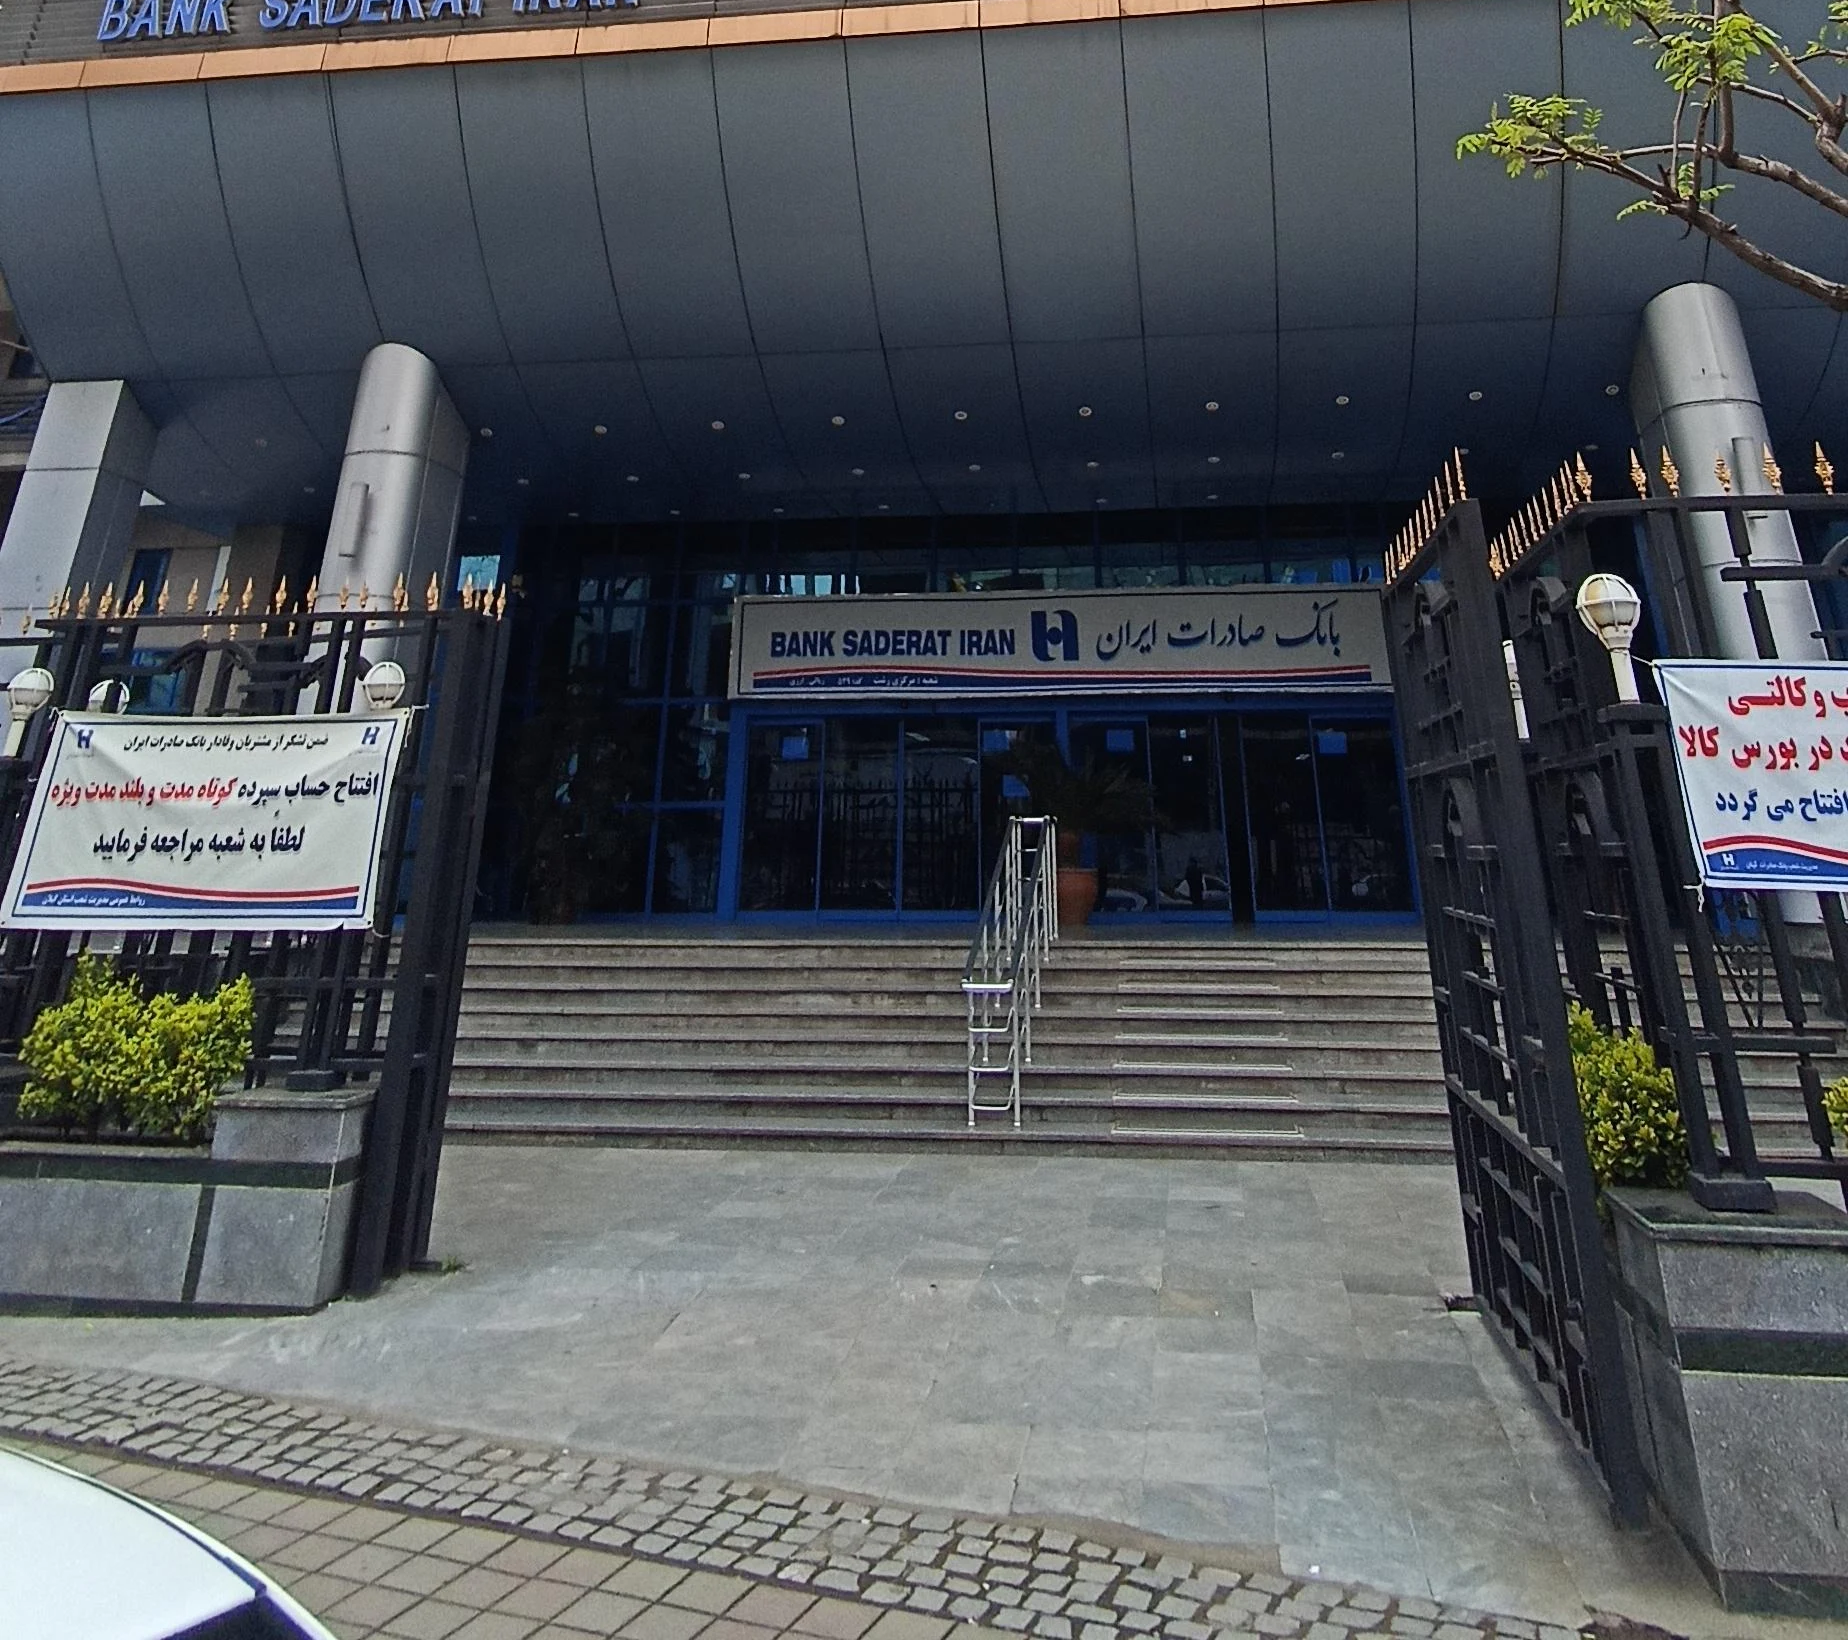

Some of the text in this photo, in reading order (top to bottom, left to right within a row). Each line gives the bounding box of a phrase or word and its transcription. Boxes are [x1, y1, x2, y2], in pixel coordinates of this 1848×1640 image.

[770, 628, 1015, 658] BANK SADERAT IRAN
[1095, 598, 1339, 661] بانک صادرات ایران
[124, 735, 150, 752] ایران
[150, 734, 184, 751] صادرات
[185, 734, 206, 748] بانک
[207, 734, 235, 751] وفادار
[236, 734, 271, 751] مشتریان
[272, 734, 285, 751] از
[1679, 725, 1719, 757] کالا
[1732, 737, 1799, 770] بورس
[1808, 735, 1833, 770] در
[51, 771, 379, 807] افتتاح حساب سپرده کوتاه مدت و بلند مدت ویژه
[1715, 788, 1758, 820] گردد
[1767, 797, 1794, 821] می
[93, 826, 147, 861] فرمایید
[151, 828, 203, 861] مراجعه
[209, 827, 245, 860] شعبه
[250, 832, 265, 860] به
